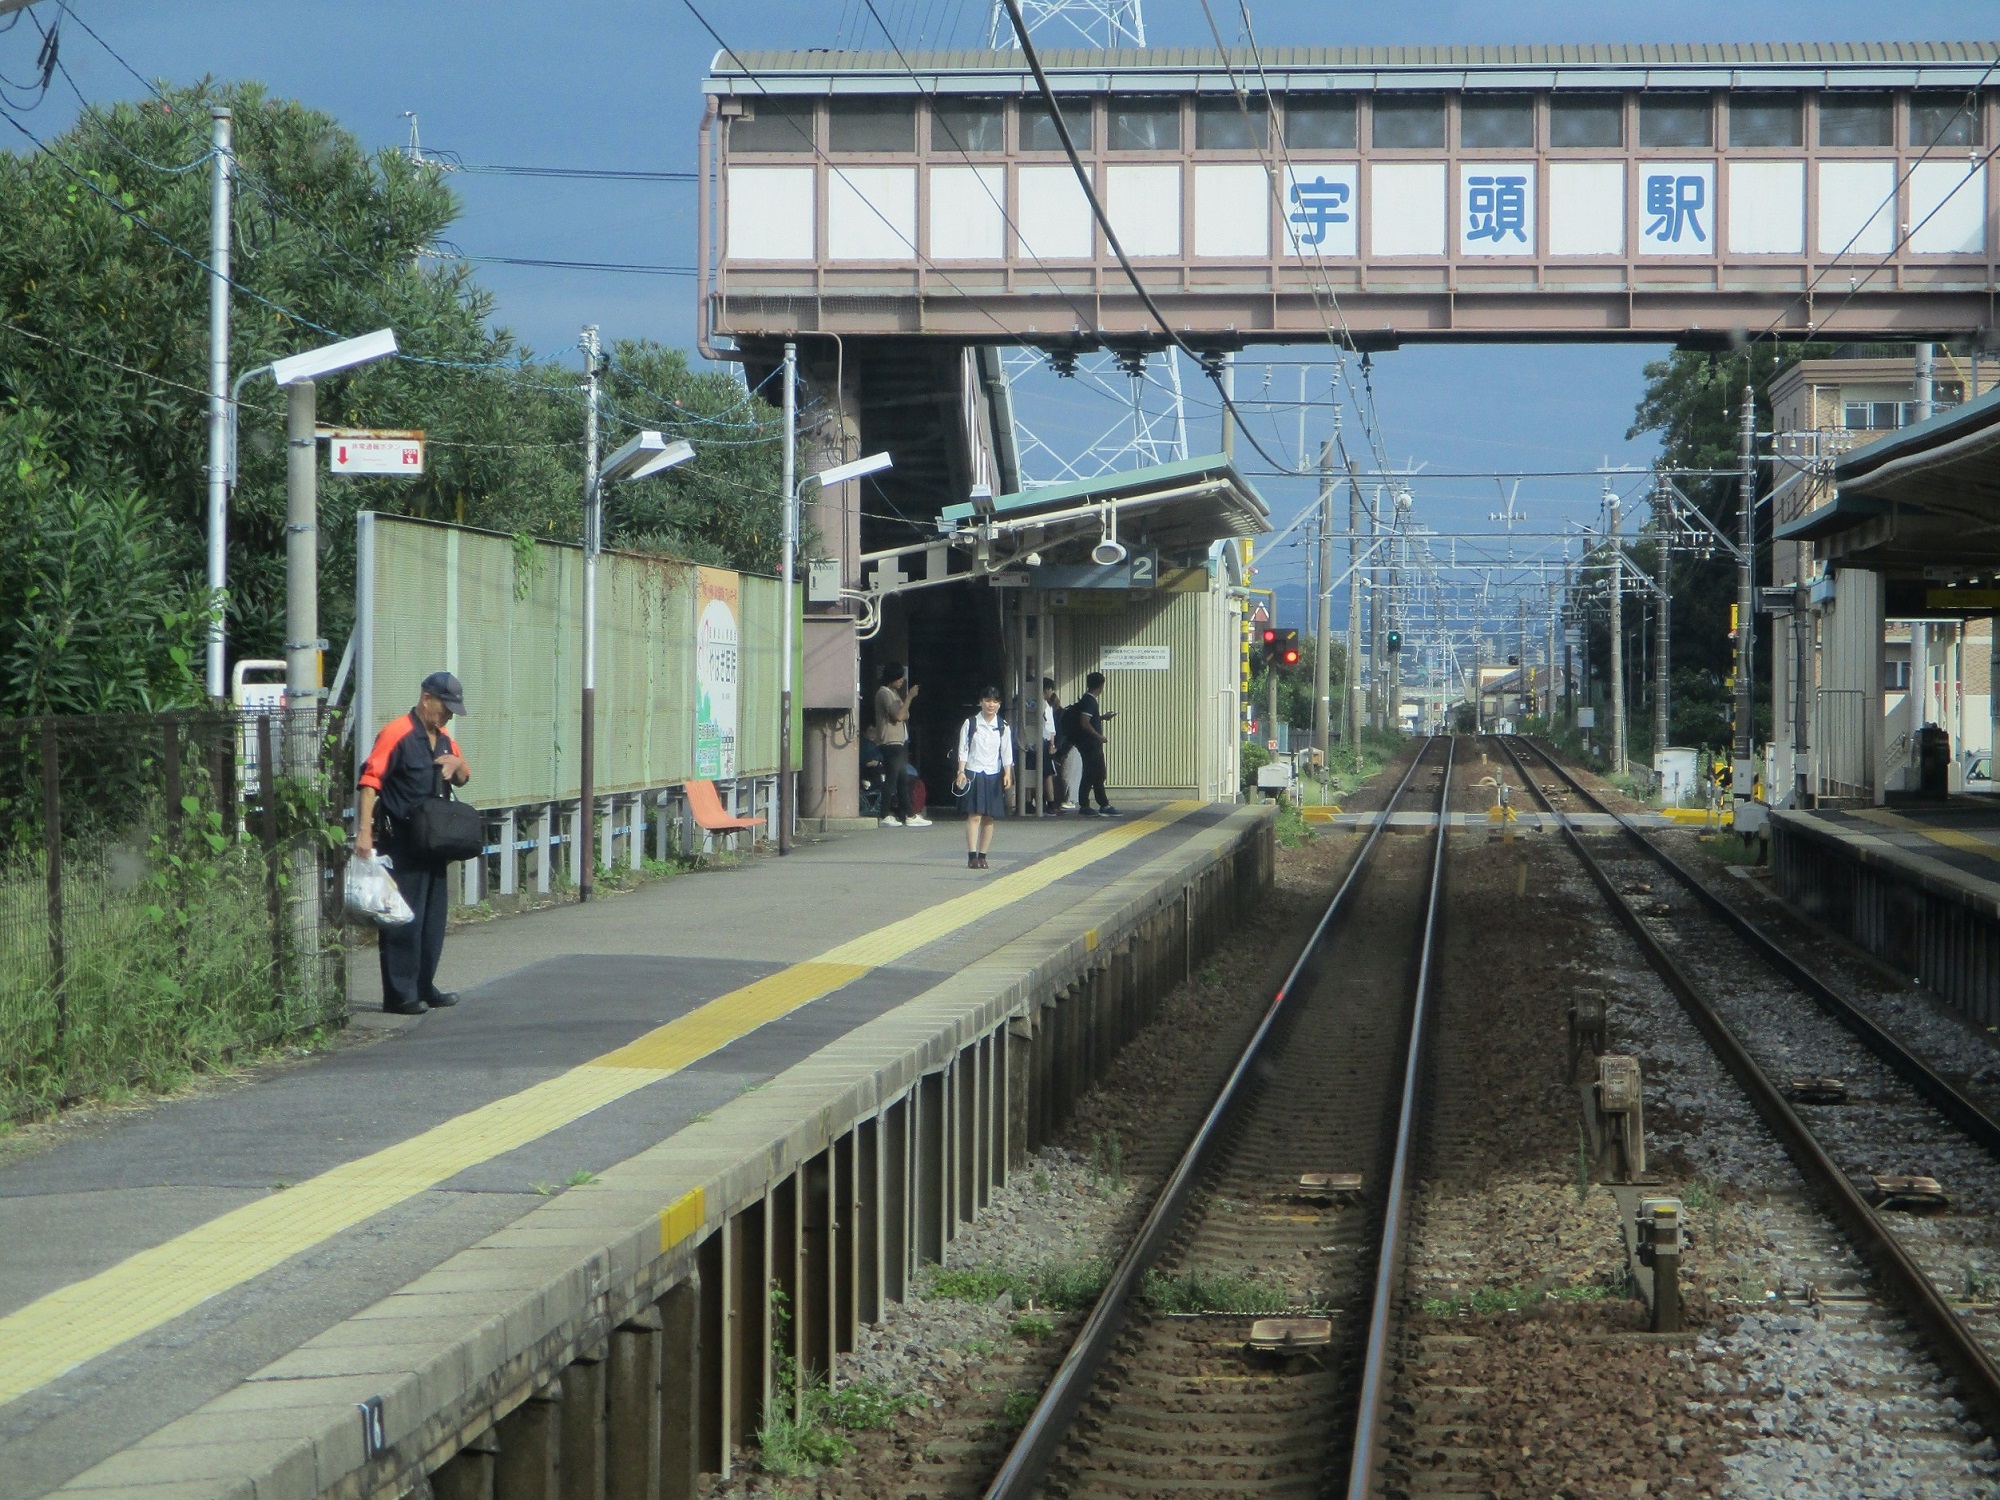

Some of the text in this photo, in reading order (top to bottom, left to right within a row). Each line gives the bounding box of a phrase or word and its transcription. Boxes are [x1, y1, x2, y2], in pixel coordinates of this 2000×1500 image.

[1290, 175, 1707, 244] 宇頭駅
[1133, 556, 1152, 579] 2
